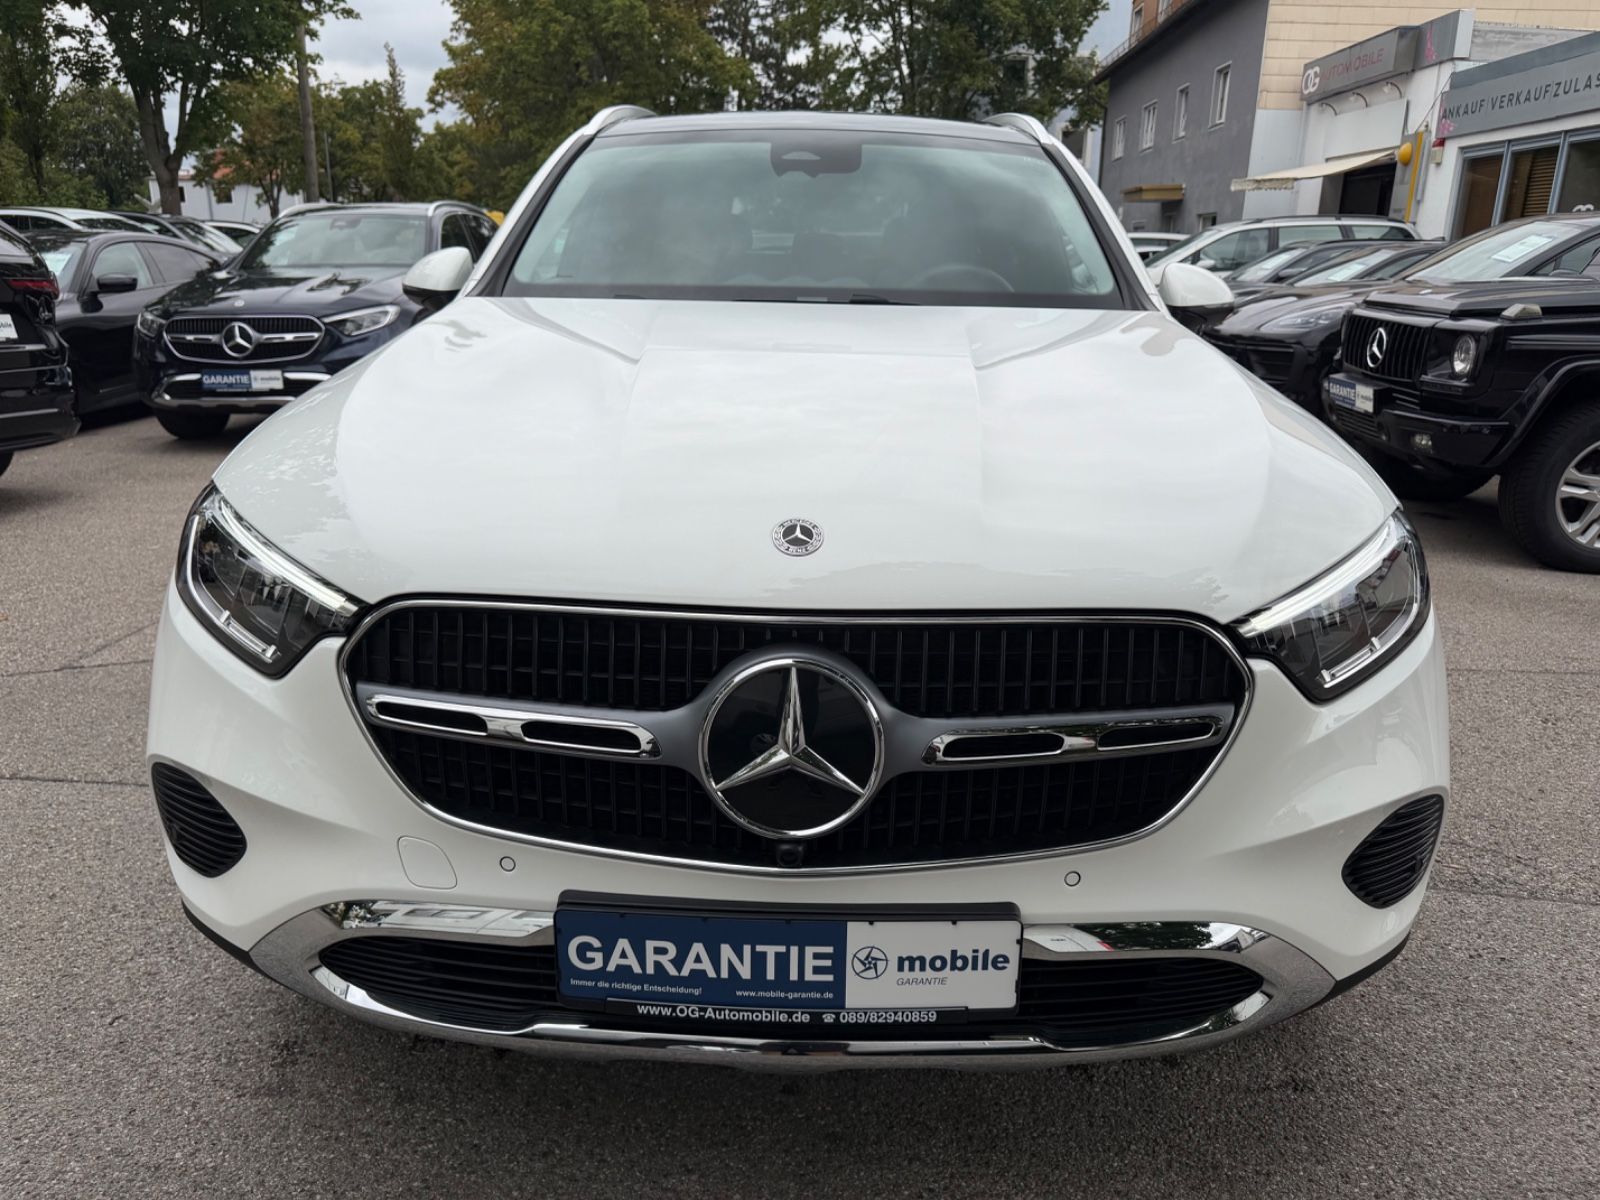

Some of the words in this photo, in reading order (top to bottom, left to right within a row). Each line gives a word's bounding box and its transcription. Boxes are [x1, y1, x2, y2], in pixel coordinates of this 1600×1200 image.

[1302, 66, 1320, 95] OG
[1321, 48, 1385, 80] AUTOMOBILE
[1442, 99, 1485, 119] ANKAUF
[1490, 84, 1551, 110] VERKAUF
[202, 375, 250, 384] GARANTIE
[567, 935, 834, 981] GARANTIE
[897, 949, 1010, 973] mobile
[570, 978, 595, 987] Immer
[597, 980, 610, 988] die
[612, 981, 642, 992] richtige
[643, 984, 702, 995] Entscheidung!
[896, 977, 948, 986] GARANTIE
[736, 990, 834, 999] www.mobile-garantie.de
[637, 1004, 810, 1022] www.OG-Automobile.de
[839, 1011, 937, 1023] 089/82940859
